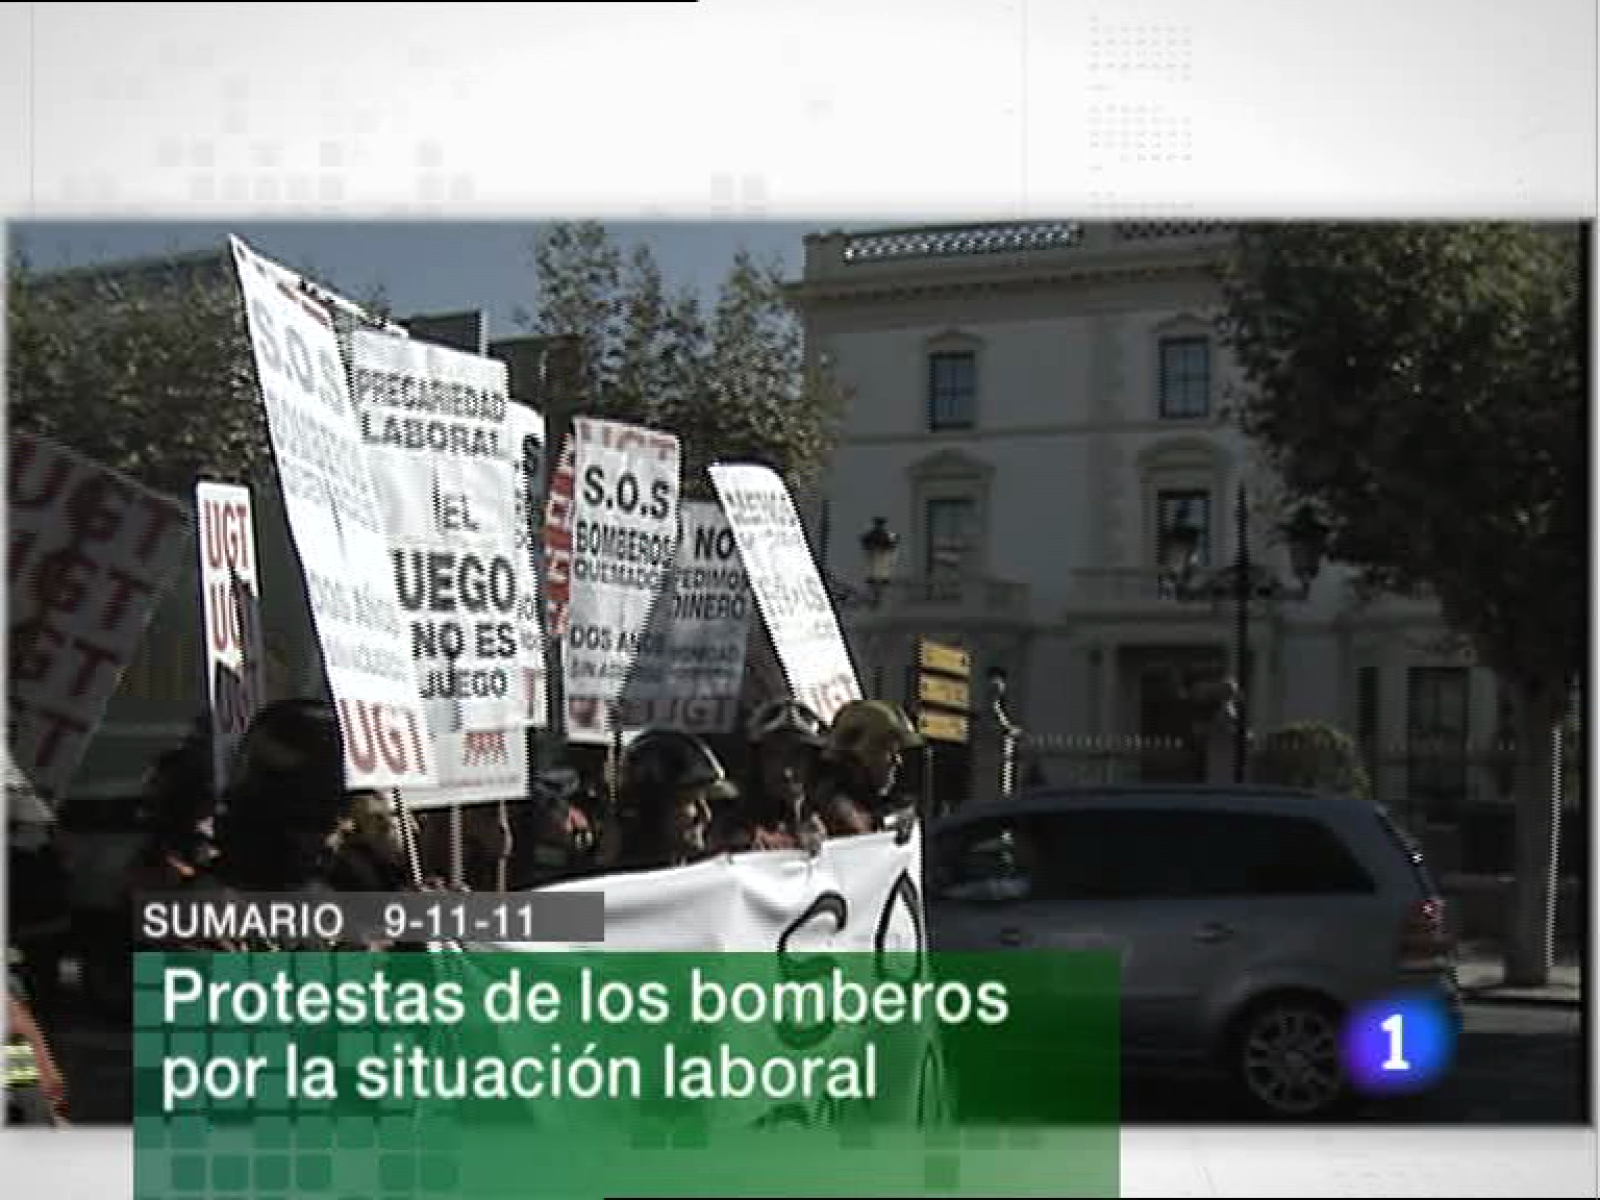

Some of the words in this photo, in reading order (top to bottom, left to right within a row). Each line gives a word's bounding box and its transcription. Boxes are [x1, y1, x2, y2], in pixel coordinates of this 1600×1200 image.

[353, 368, 507, 425] PRECARIEDAD
[360, 410, 504, 458] LABORAL
[583, 464, 671, 521] S.O.S
[203, 499, 251, 570] UGT
[575, 521, 675, 568] BOMBEROS
[694, 526, 736, 561] NO
[393, 548, 517, 613] UEGO
[411, 621, 465, 659] NO
[475, 622, 517, 659] ES
[570, 624, 613, 652] DOS
[418, 666, 509, 699] JUEGO
[339, 698, 427, 776] UGT
